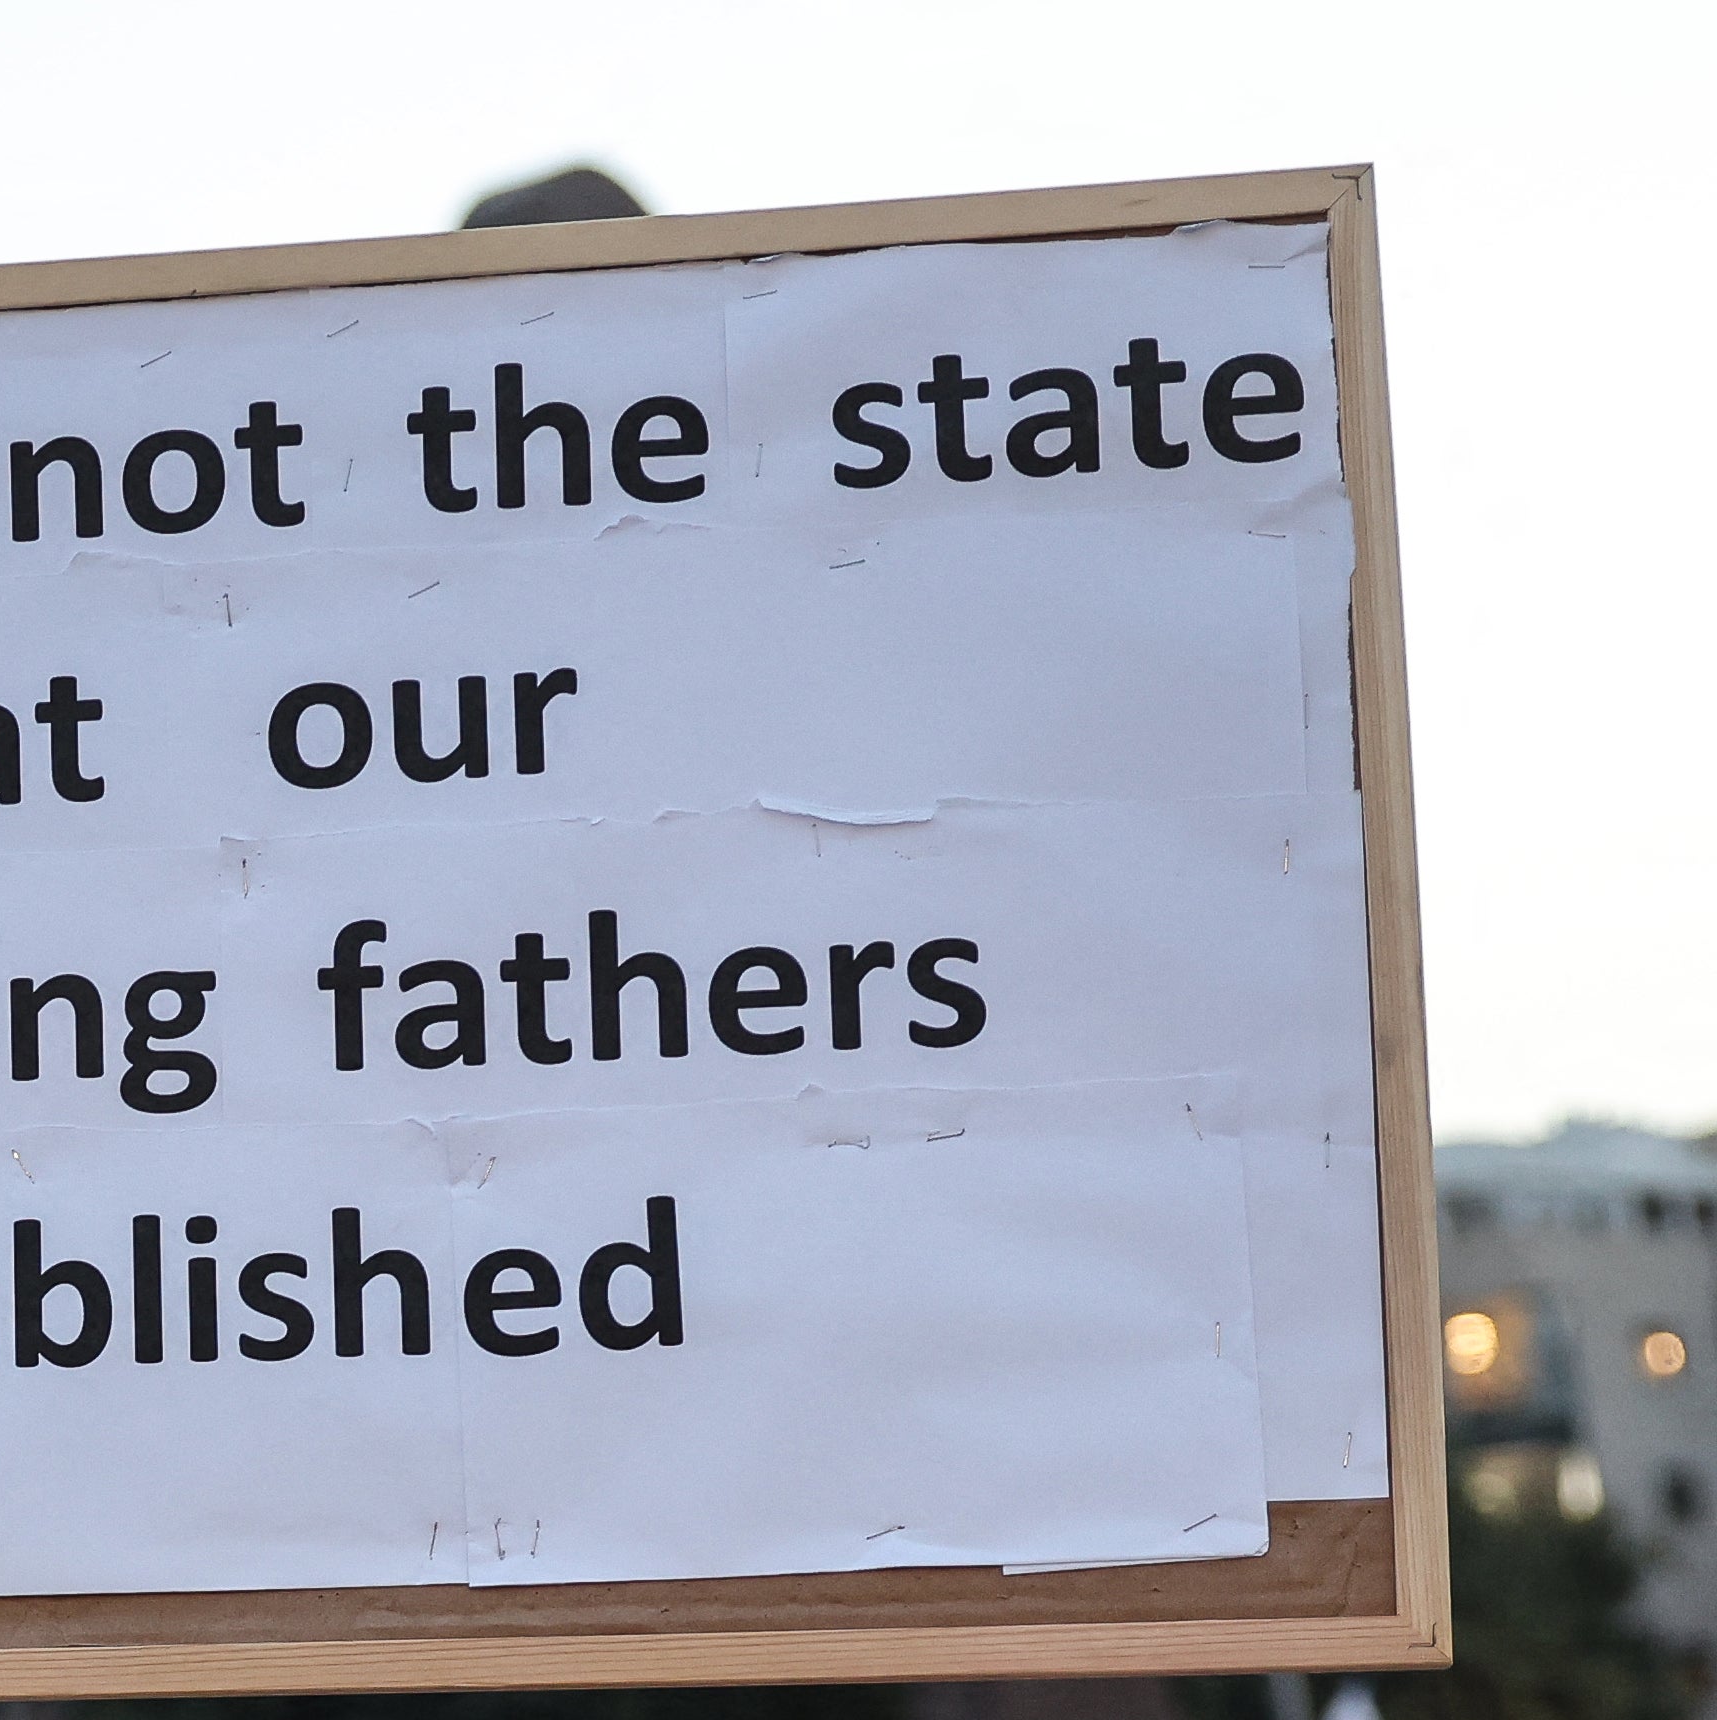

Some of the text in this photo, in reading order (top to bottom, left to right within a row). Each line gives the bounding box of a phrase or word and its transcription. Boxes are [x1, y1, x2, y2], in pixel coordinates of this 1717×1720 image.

[8, 401, 307, 544] not
[406, 362, 710, 515] the
[831, 337, 1306, 490] state
[267, 667, 579, 791] our
[316, 909, 988, 1073] fathers
